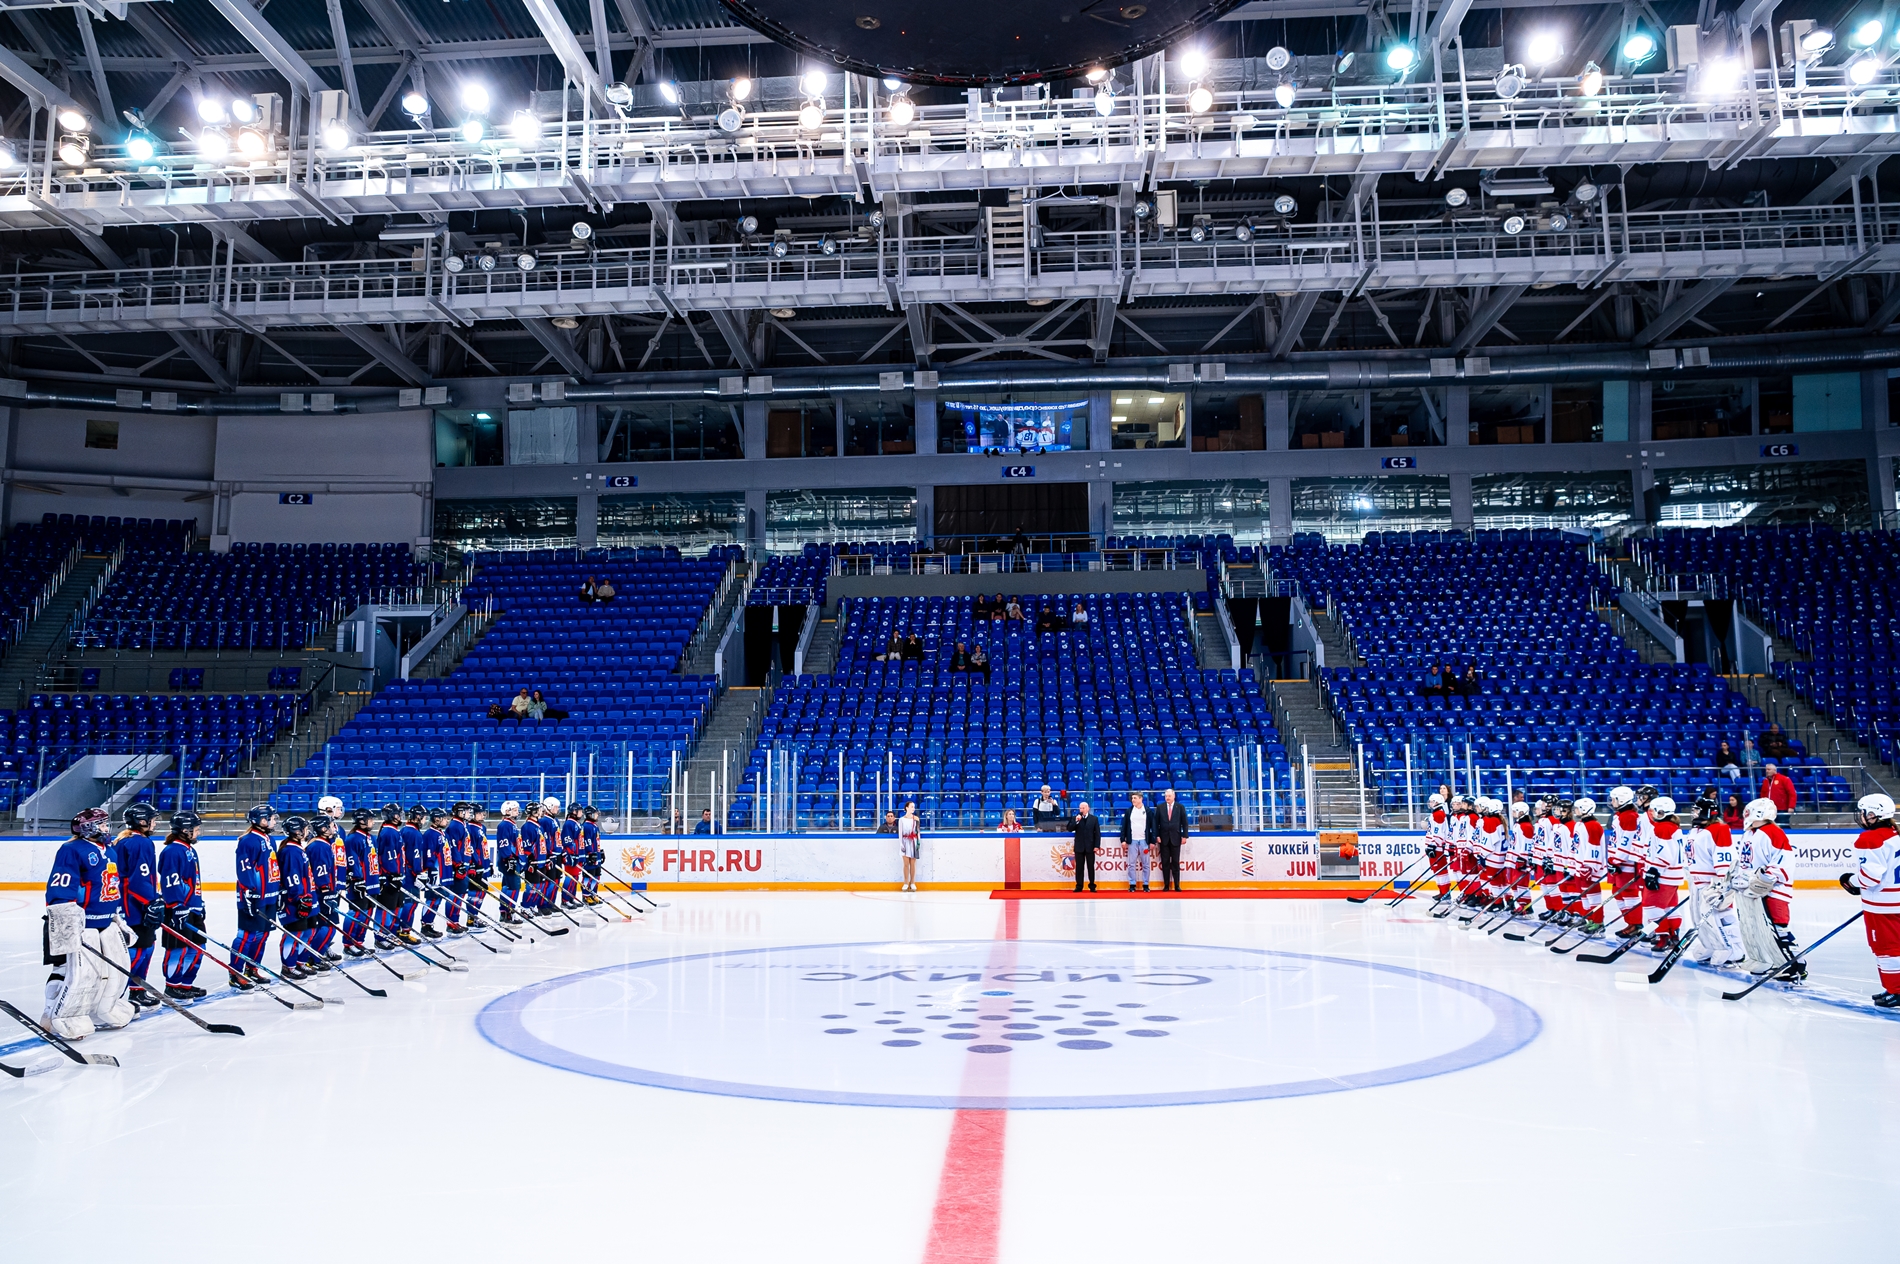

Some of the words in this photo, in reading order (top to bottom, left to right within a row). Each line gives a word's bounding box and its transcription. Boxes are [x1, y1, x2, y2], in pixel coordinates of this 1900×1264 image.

[1770, 445, 1788, 455] C6
[1390, 458, 1408, 468] C5
[1011, 467, 1026, 476] C4
[614, 477, 629, 486] C3
[288, 494, 303, 503] C2
[499, 838, 509, 848] 23
[1268, 841, 1309, 855] ХОККЕЙ
[1386, 843, 1421, 857] ЗДЕСЬ
[1591, 849, 1600, 858] 10
[662, 849, 762, 872] FHR.RU
[1716, 852, 1732, 863] 30
[140, 864, 150, 876] 9
[317, 865, 328, 877] 21
[1151, 861, 1205, 871] РОСИИ
[51, 872, 71, 888] 20
[165, 872, 181, 888] 12
[287, 874, 299, 887] 18
[799, 969, 1213, 987] Сириус
